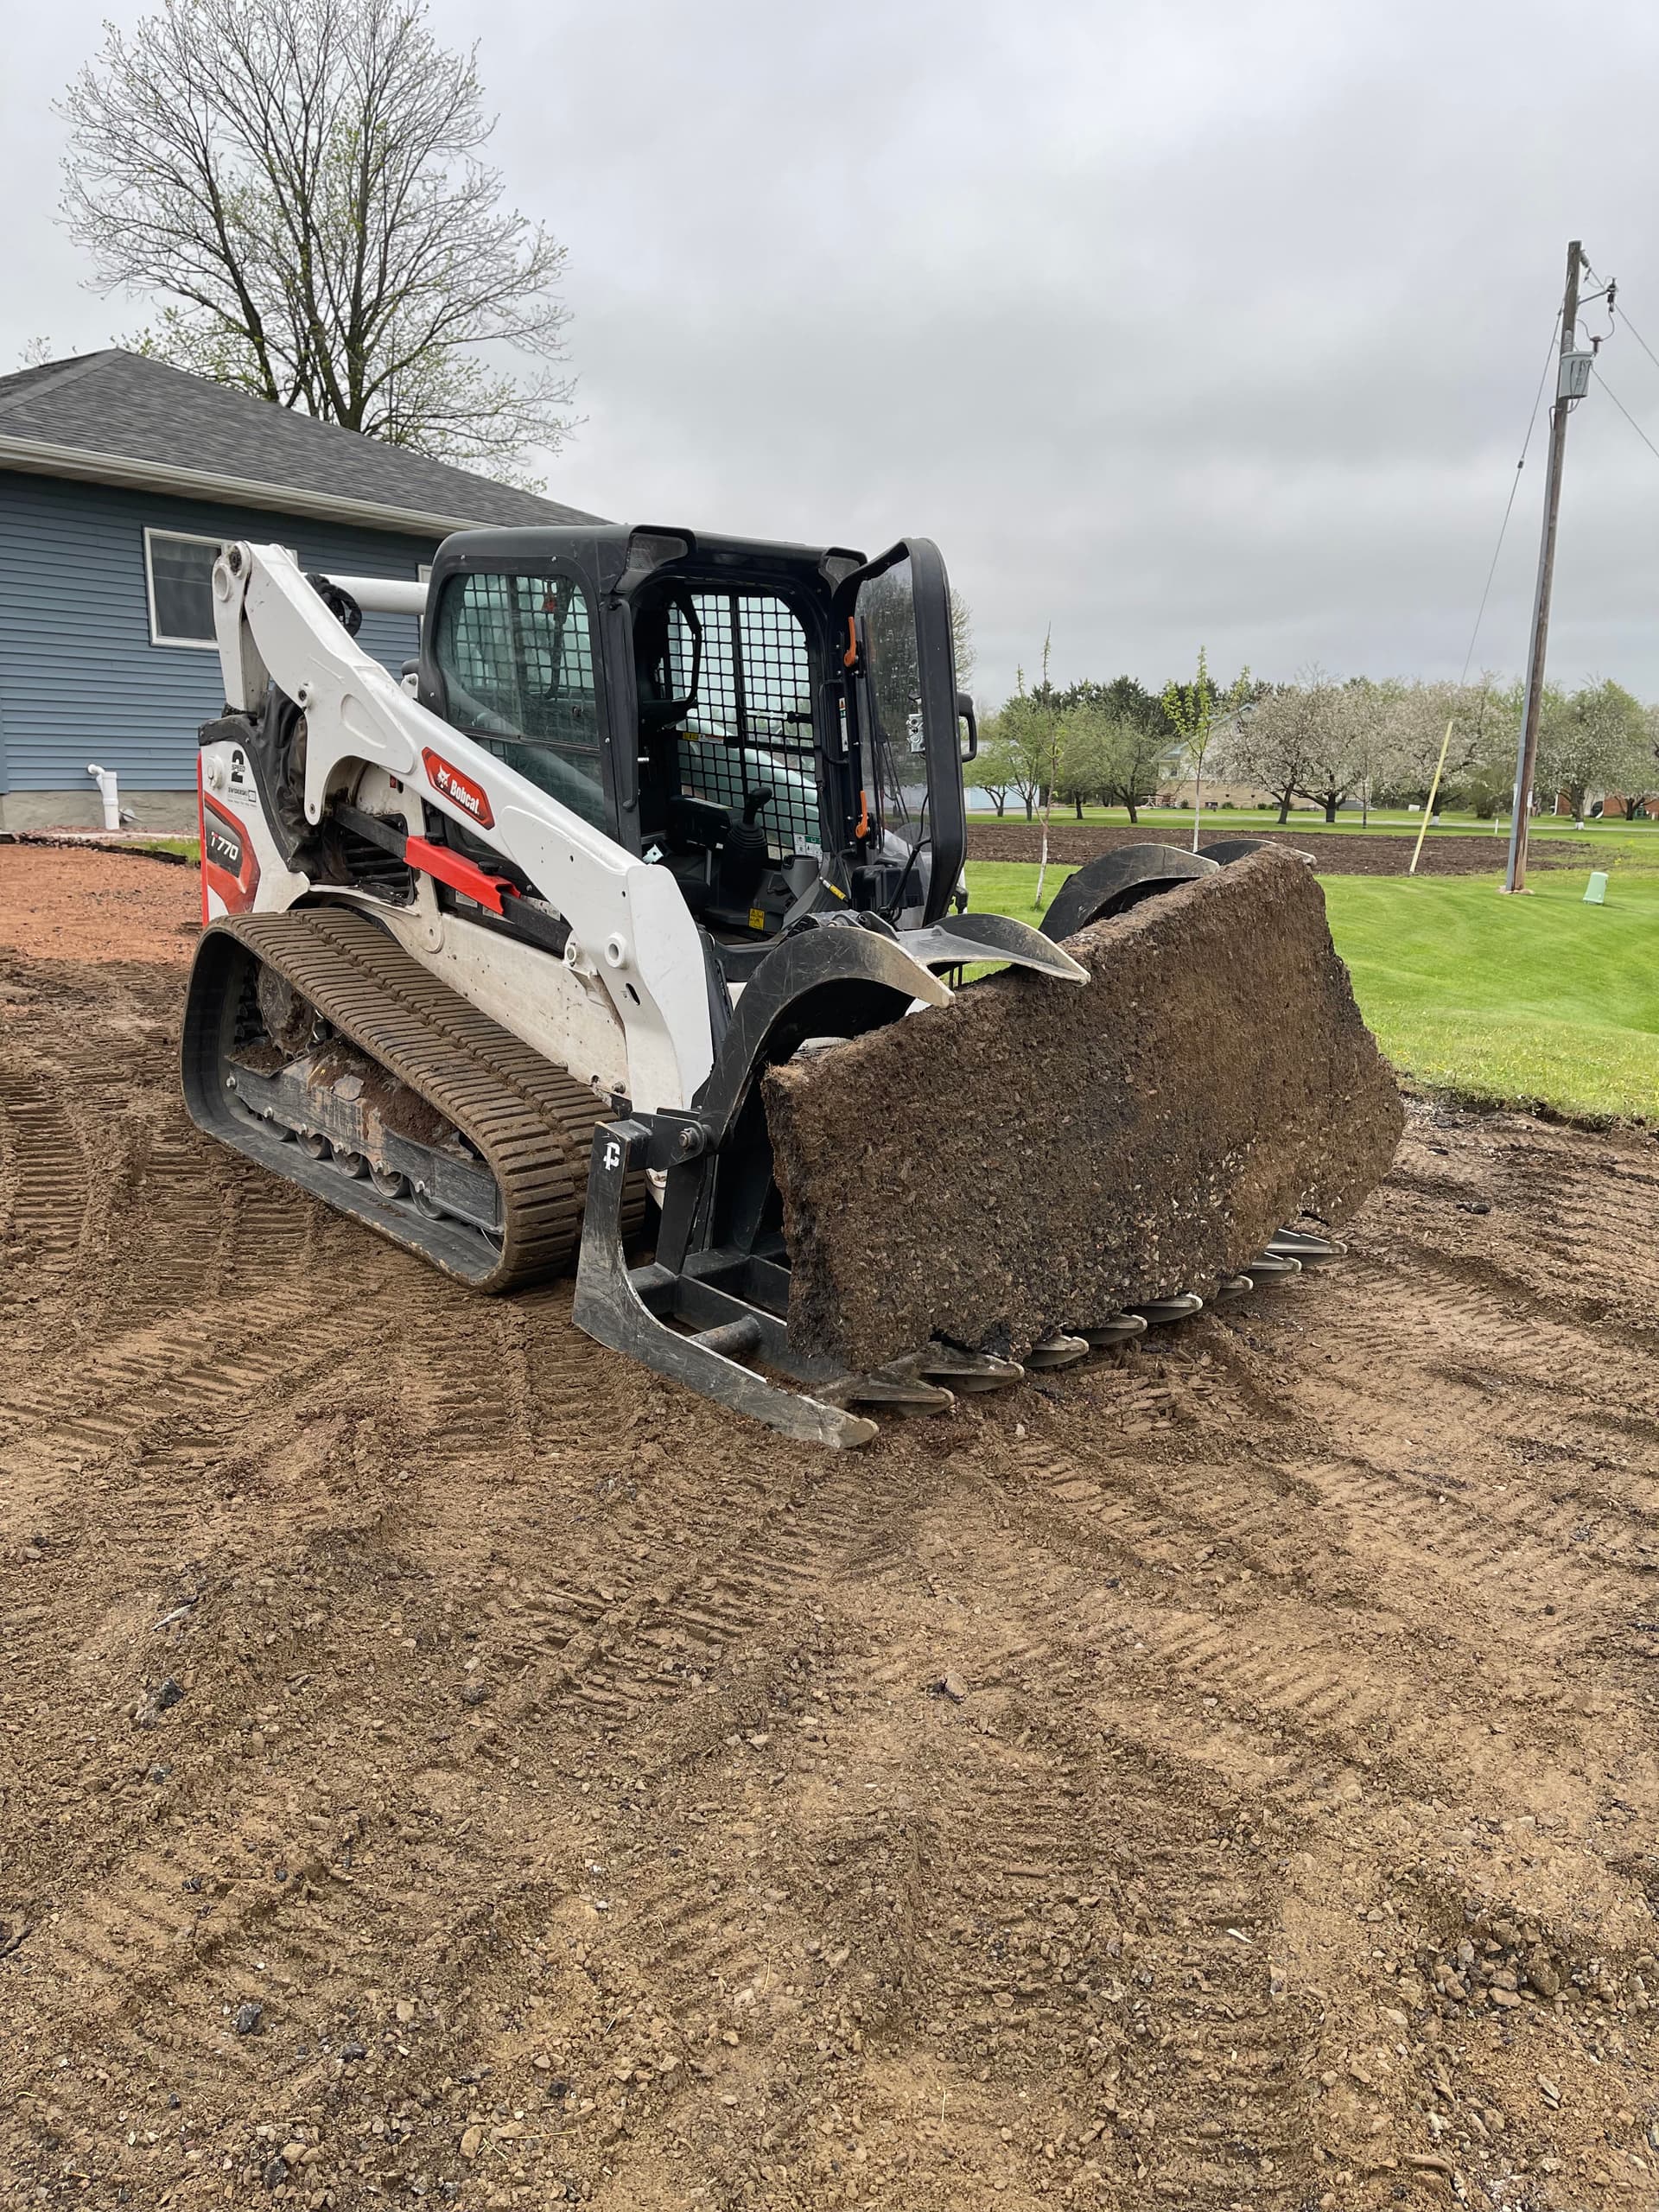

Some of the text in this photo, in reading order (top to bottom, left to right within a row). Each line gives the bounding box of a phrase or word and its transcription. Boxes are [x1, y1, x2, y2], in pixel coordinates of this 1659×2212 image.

[231, 749, 245, 784] 2
[232, 764, 246, 772] SPEED
[449, 779, 480, 815] Bobcat
[211, 831, 239, 861] T770
